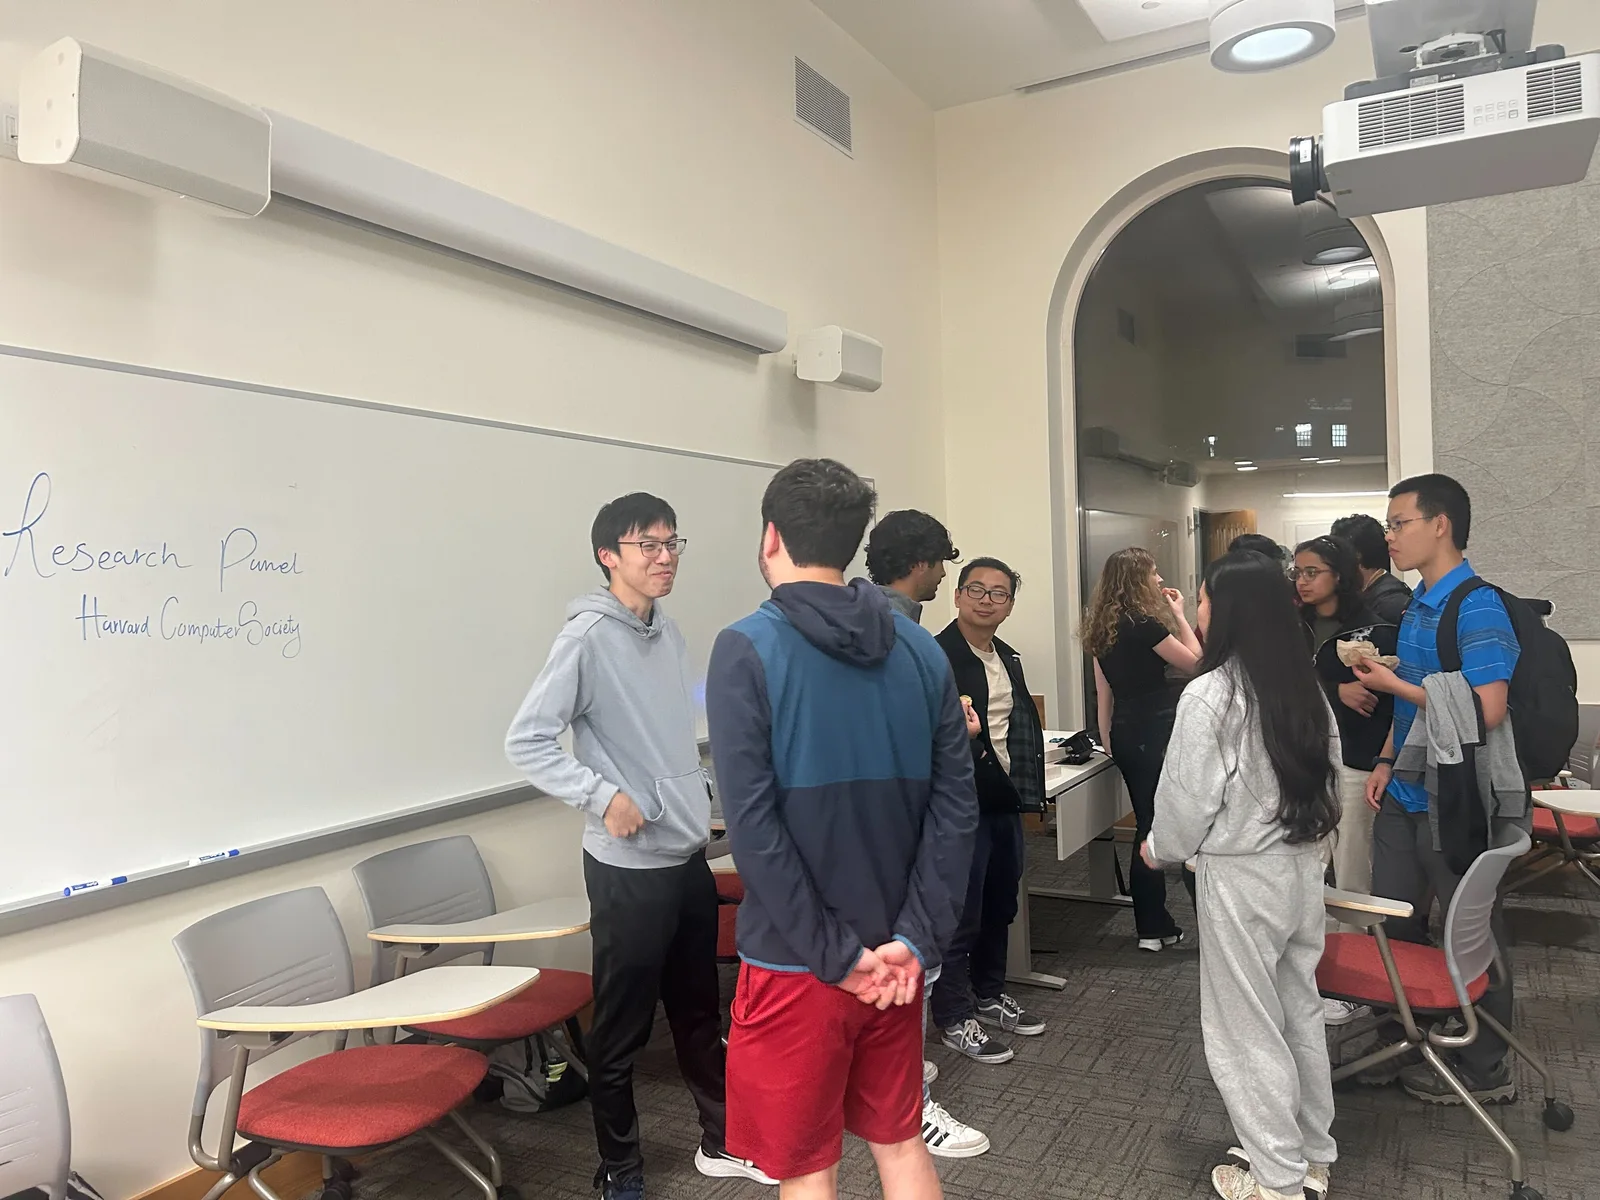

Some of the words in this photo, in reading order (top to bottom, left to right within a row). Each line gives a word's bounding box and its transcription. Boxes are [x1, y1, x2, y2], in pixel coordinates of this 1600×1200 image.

[3, 472, 192, 578] Research
[75, 594, 152, 640] Harvard
[160, 596, 241, 644] Computer
[237, 601, 301, 658] Society
